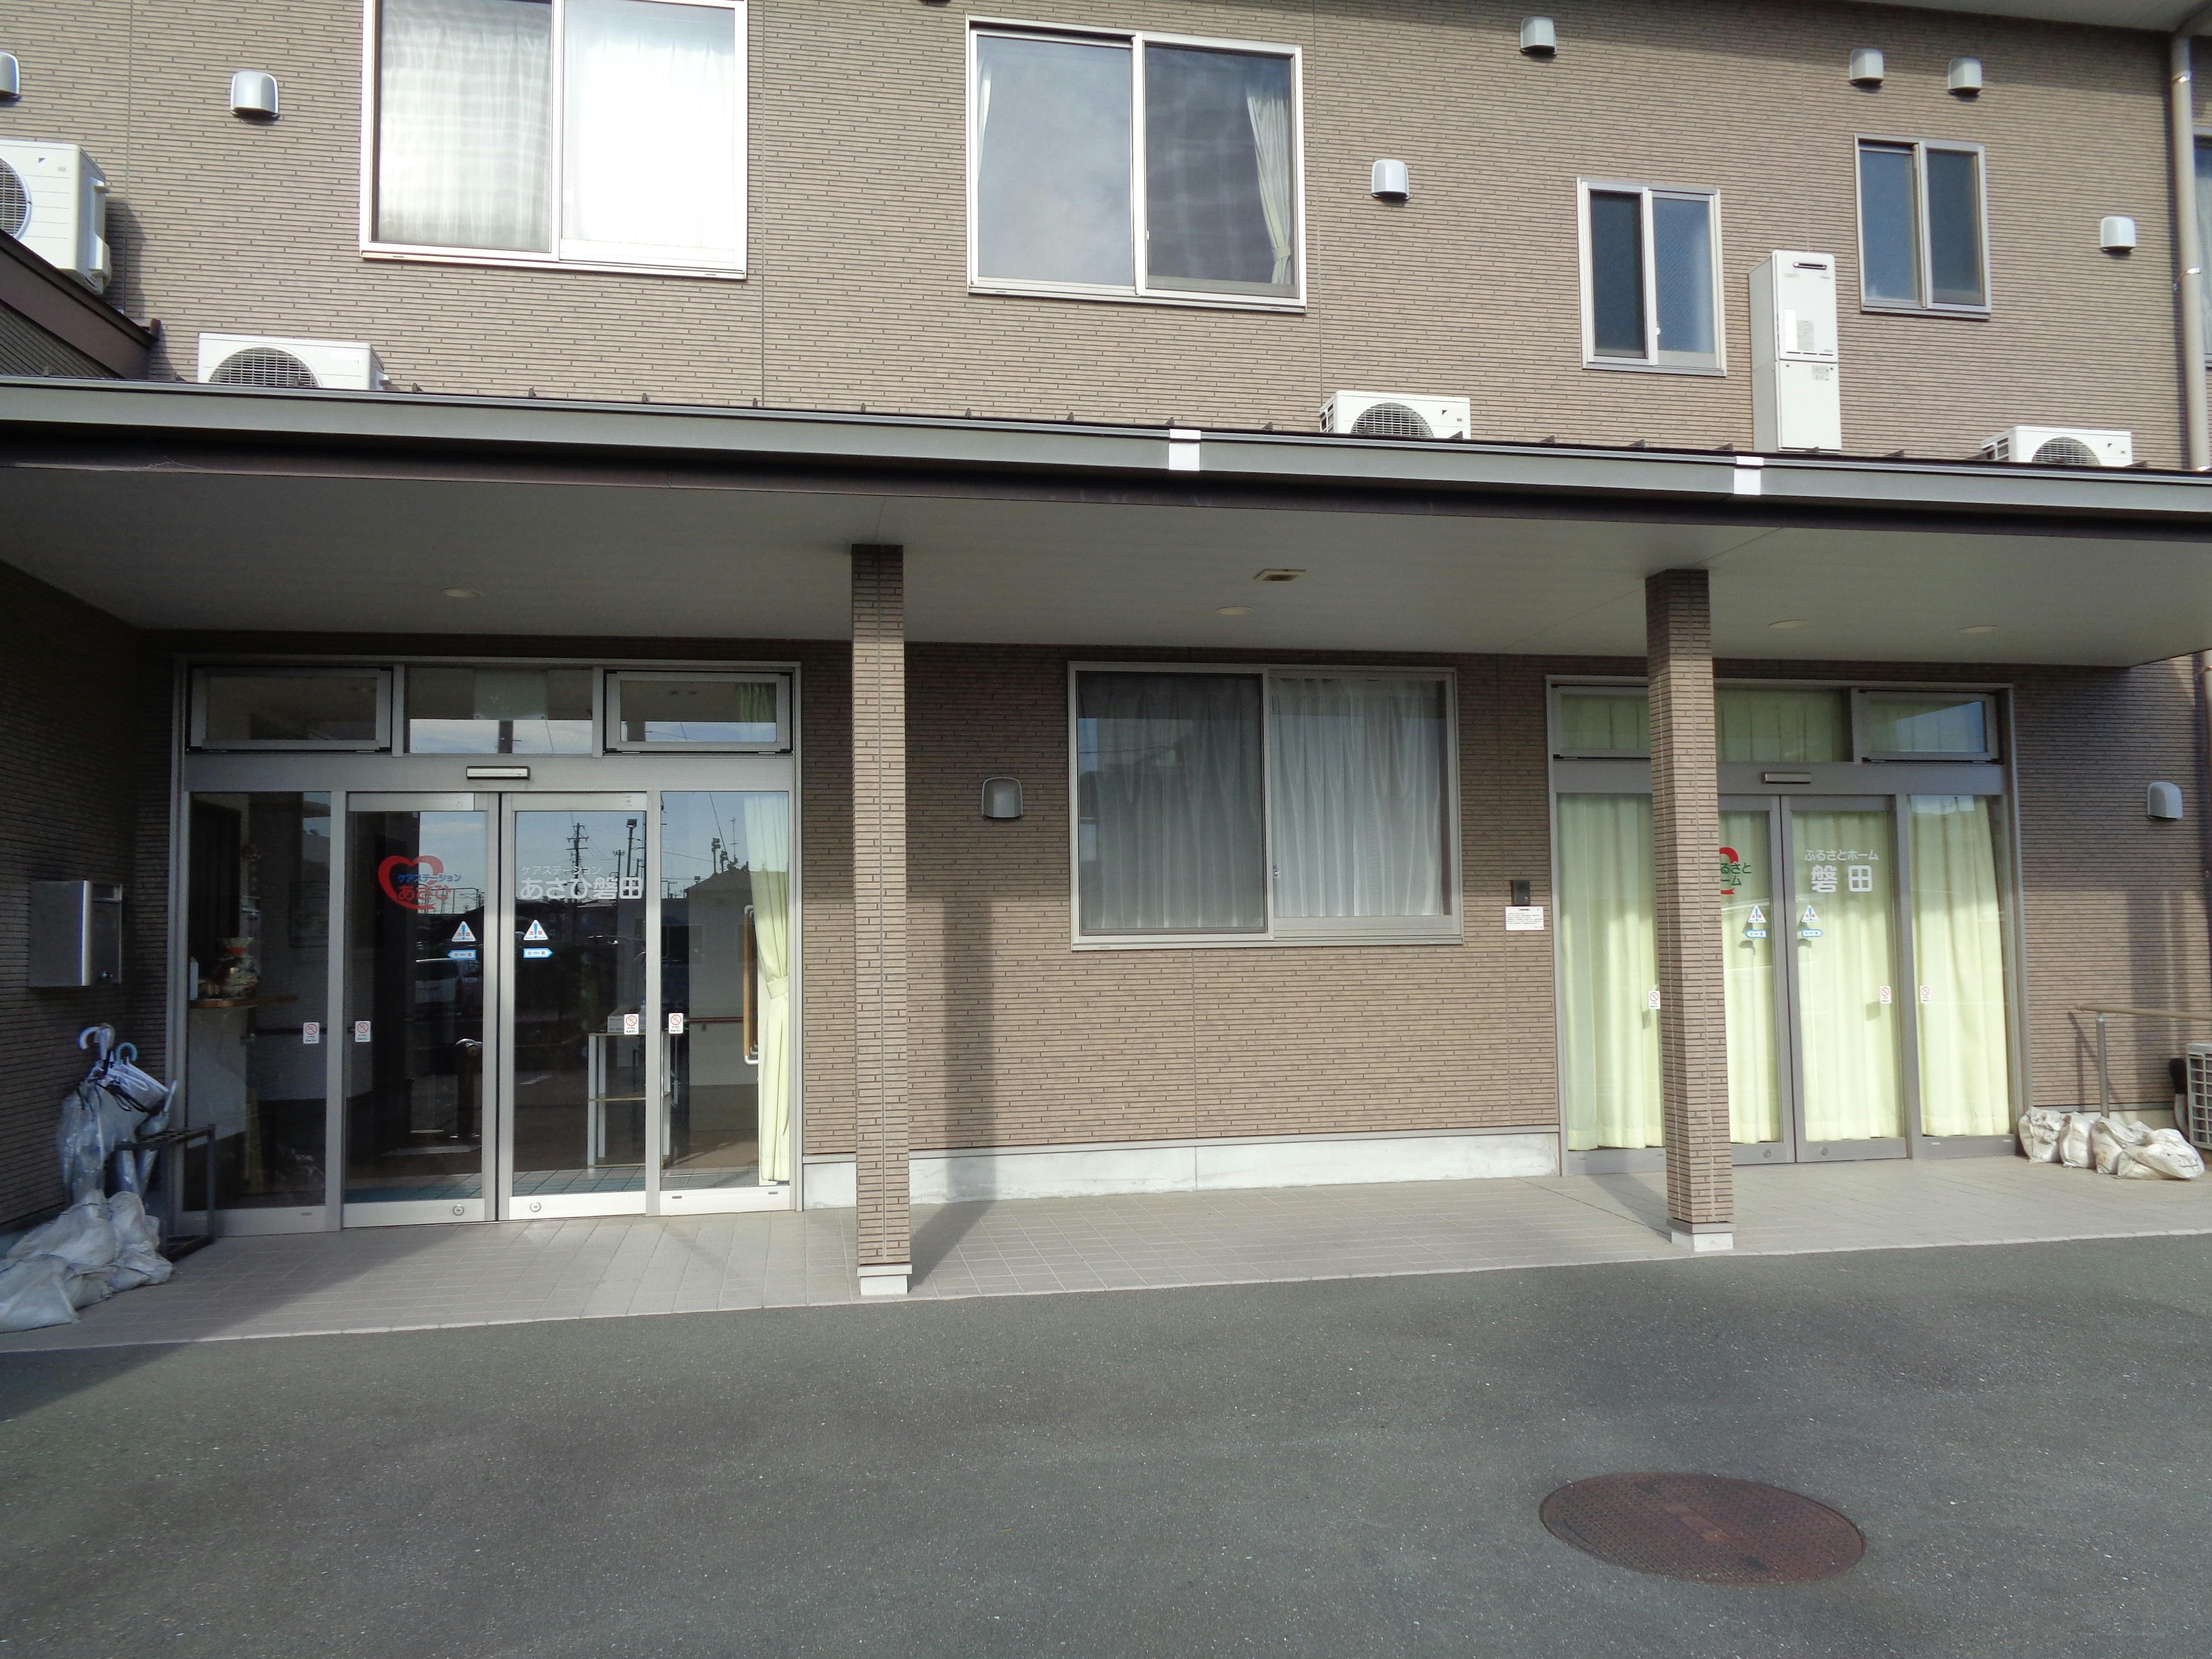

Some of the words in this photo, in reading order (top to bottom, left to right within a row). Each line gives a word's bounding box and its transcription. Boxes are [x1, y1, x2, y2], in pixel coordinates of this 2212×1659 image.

[1805, 849, 1879, 861] ふるさとホーム
[522, 866, 601, 875] ケアステーション
[1720, 863, 1752, 874] るさと
[398, 873, 462, 882] ケアステーション
[1720, 875, 1741, 886] ーム
[1811, 864, 1872, 893] 磐田
[398, 883, 451, 901] あさひ
[520, 877, 642, 899] あさひ磐田
